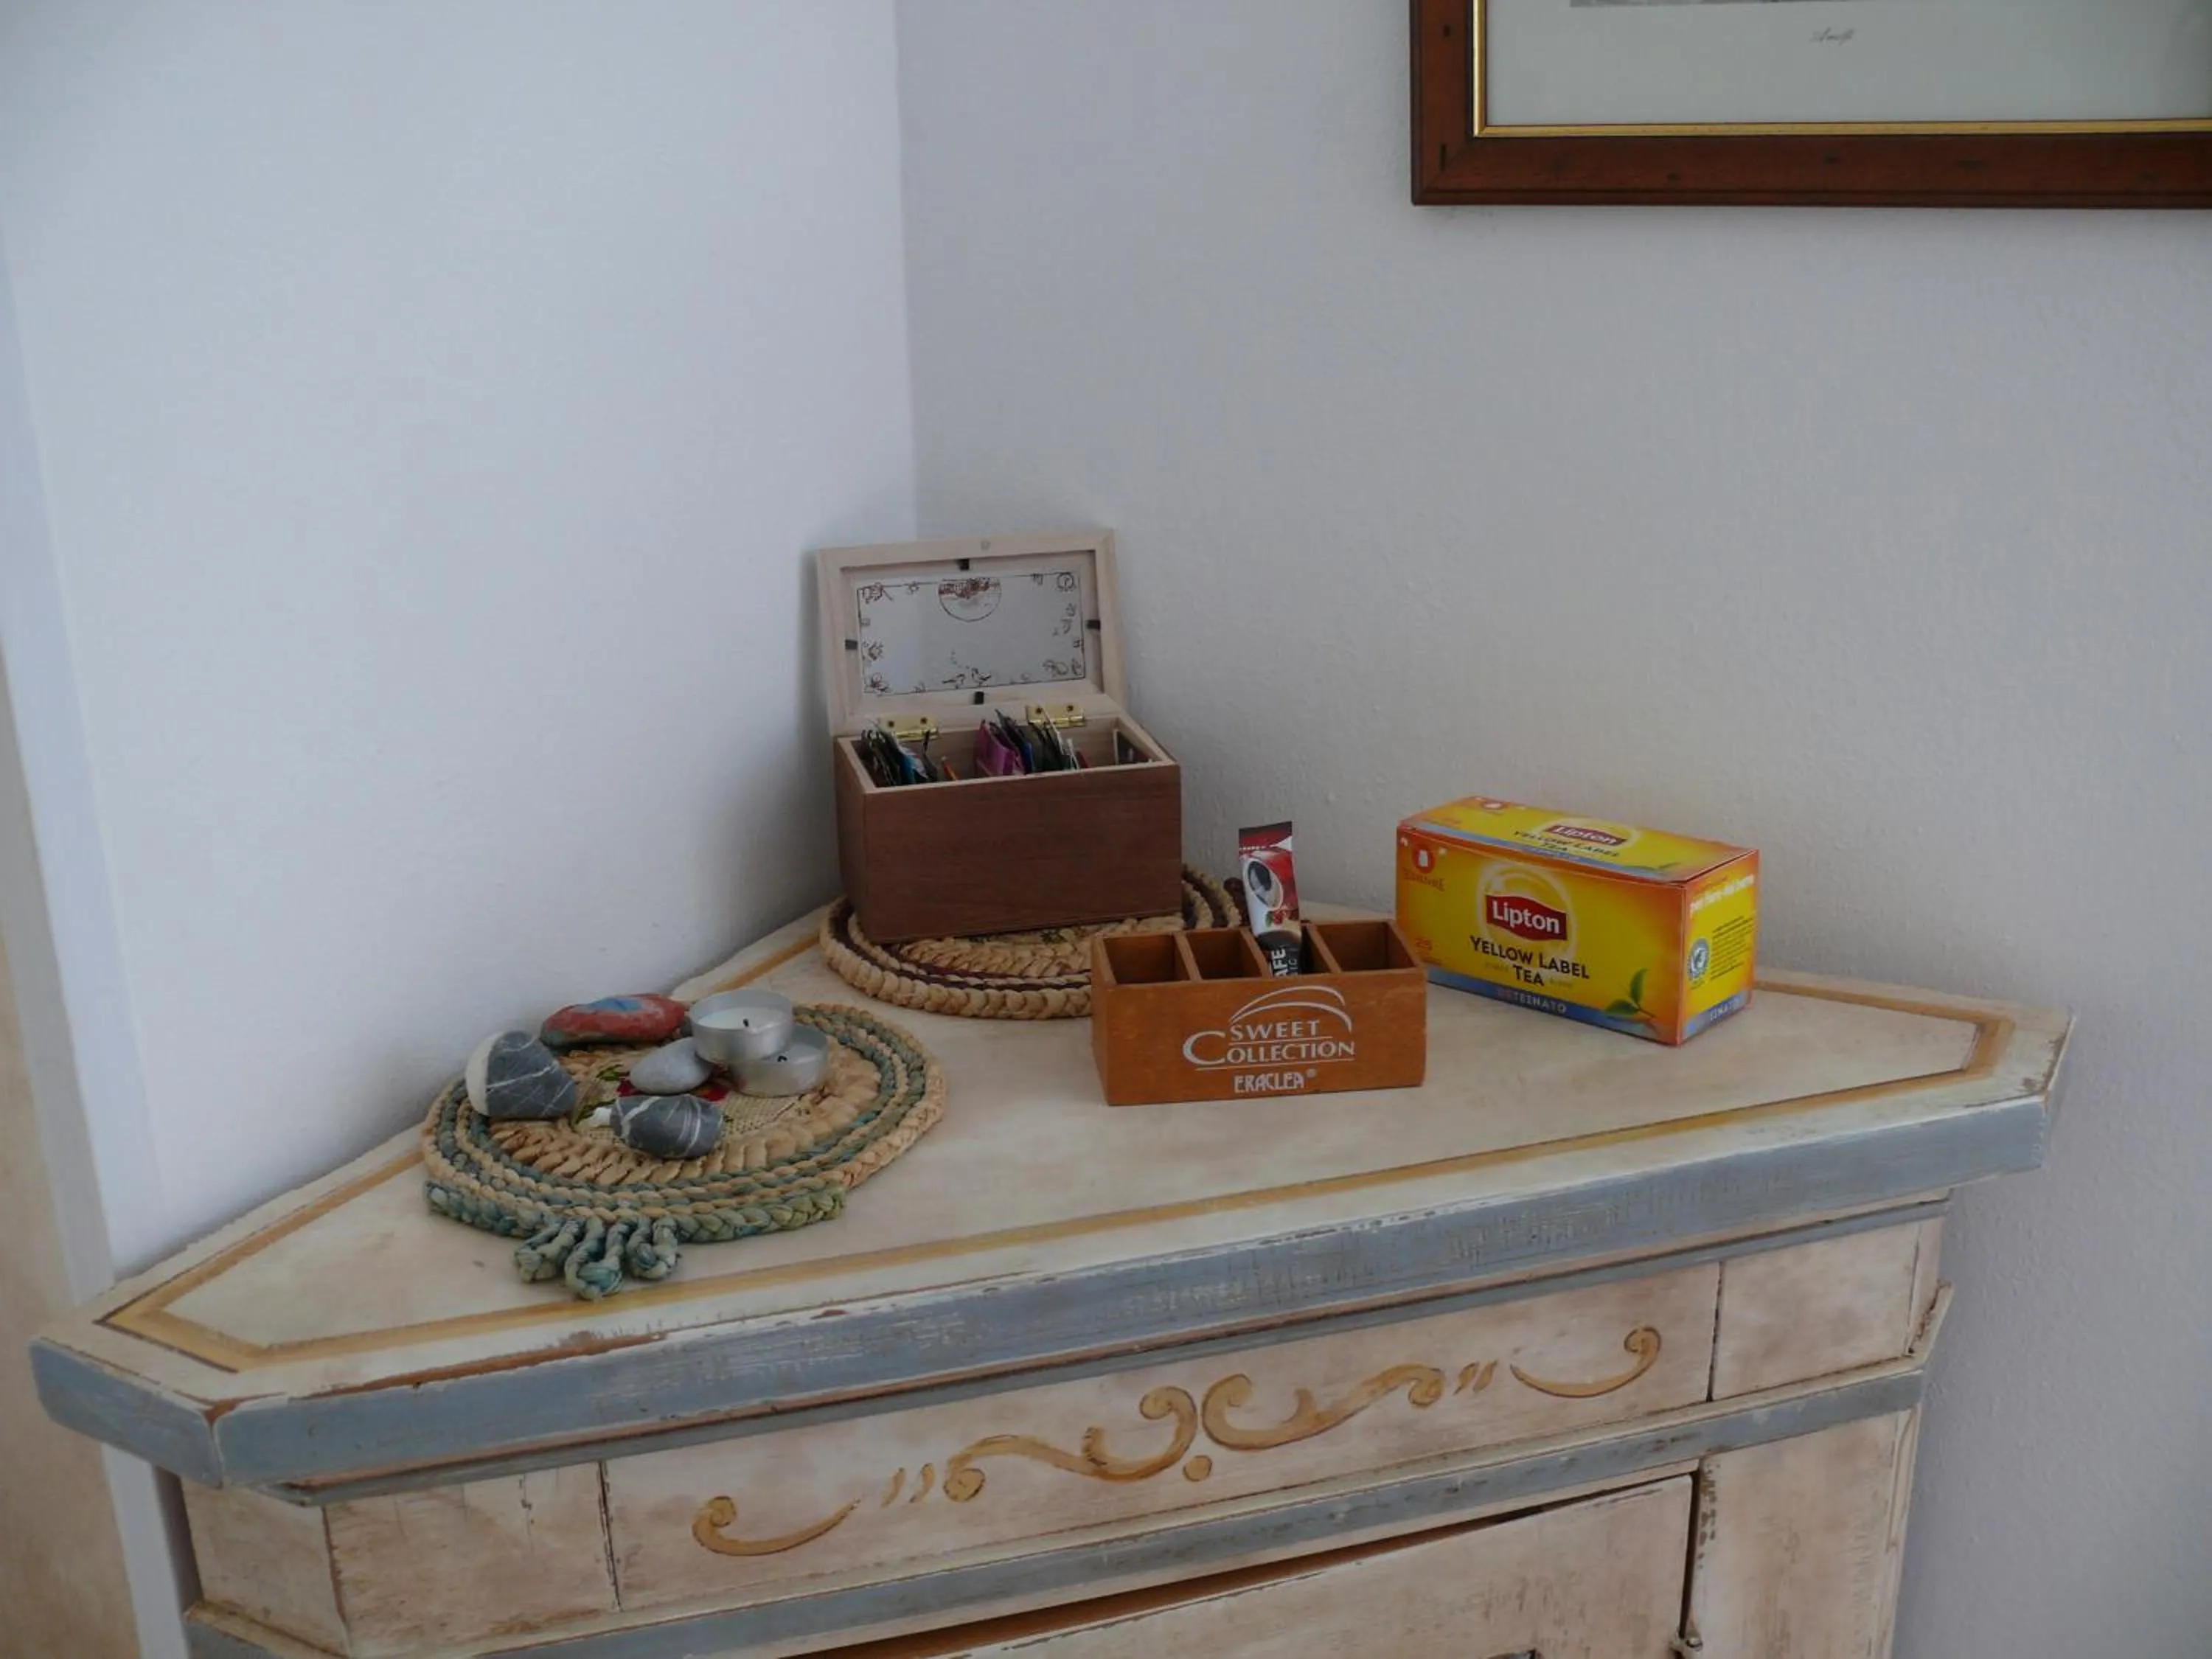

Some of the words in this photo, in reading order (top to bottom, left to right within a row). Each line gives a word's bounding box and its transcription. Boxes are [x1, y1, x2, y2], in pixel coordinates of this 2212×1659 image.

[1492, 899, 1560, 934] Lipton
[1470, 935, 1534, 963] YELLOW
[1539, 953, 1590, 979] LABEL
[1513, 963, 1545, 987] TEA
[1230, 1019, 1321, 1042] SWEET
[1182, 1030, 1355, 1065] COLLECTION
[1234, 1071, 1305, 1093] ERACLEA
